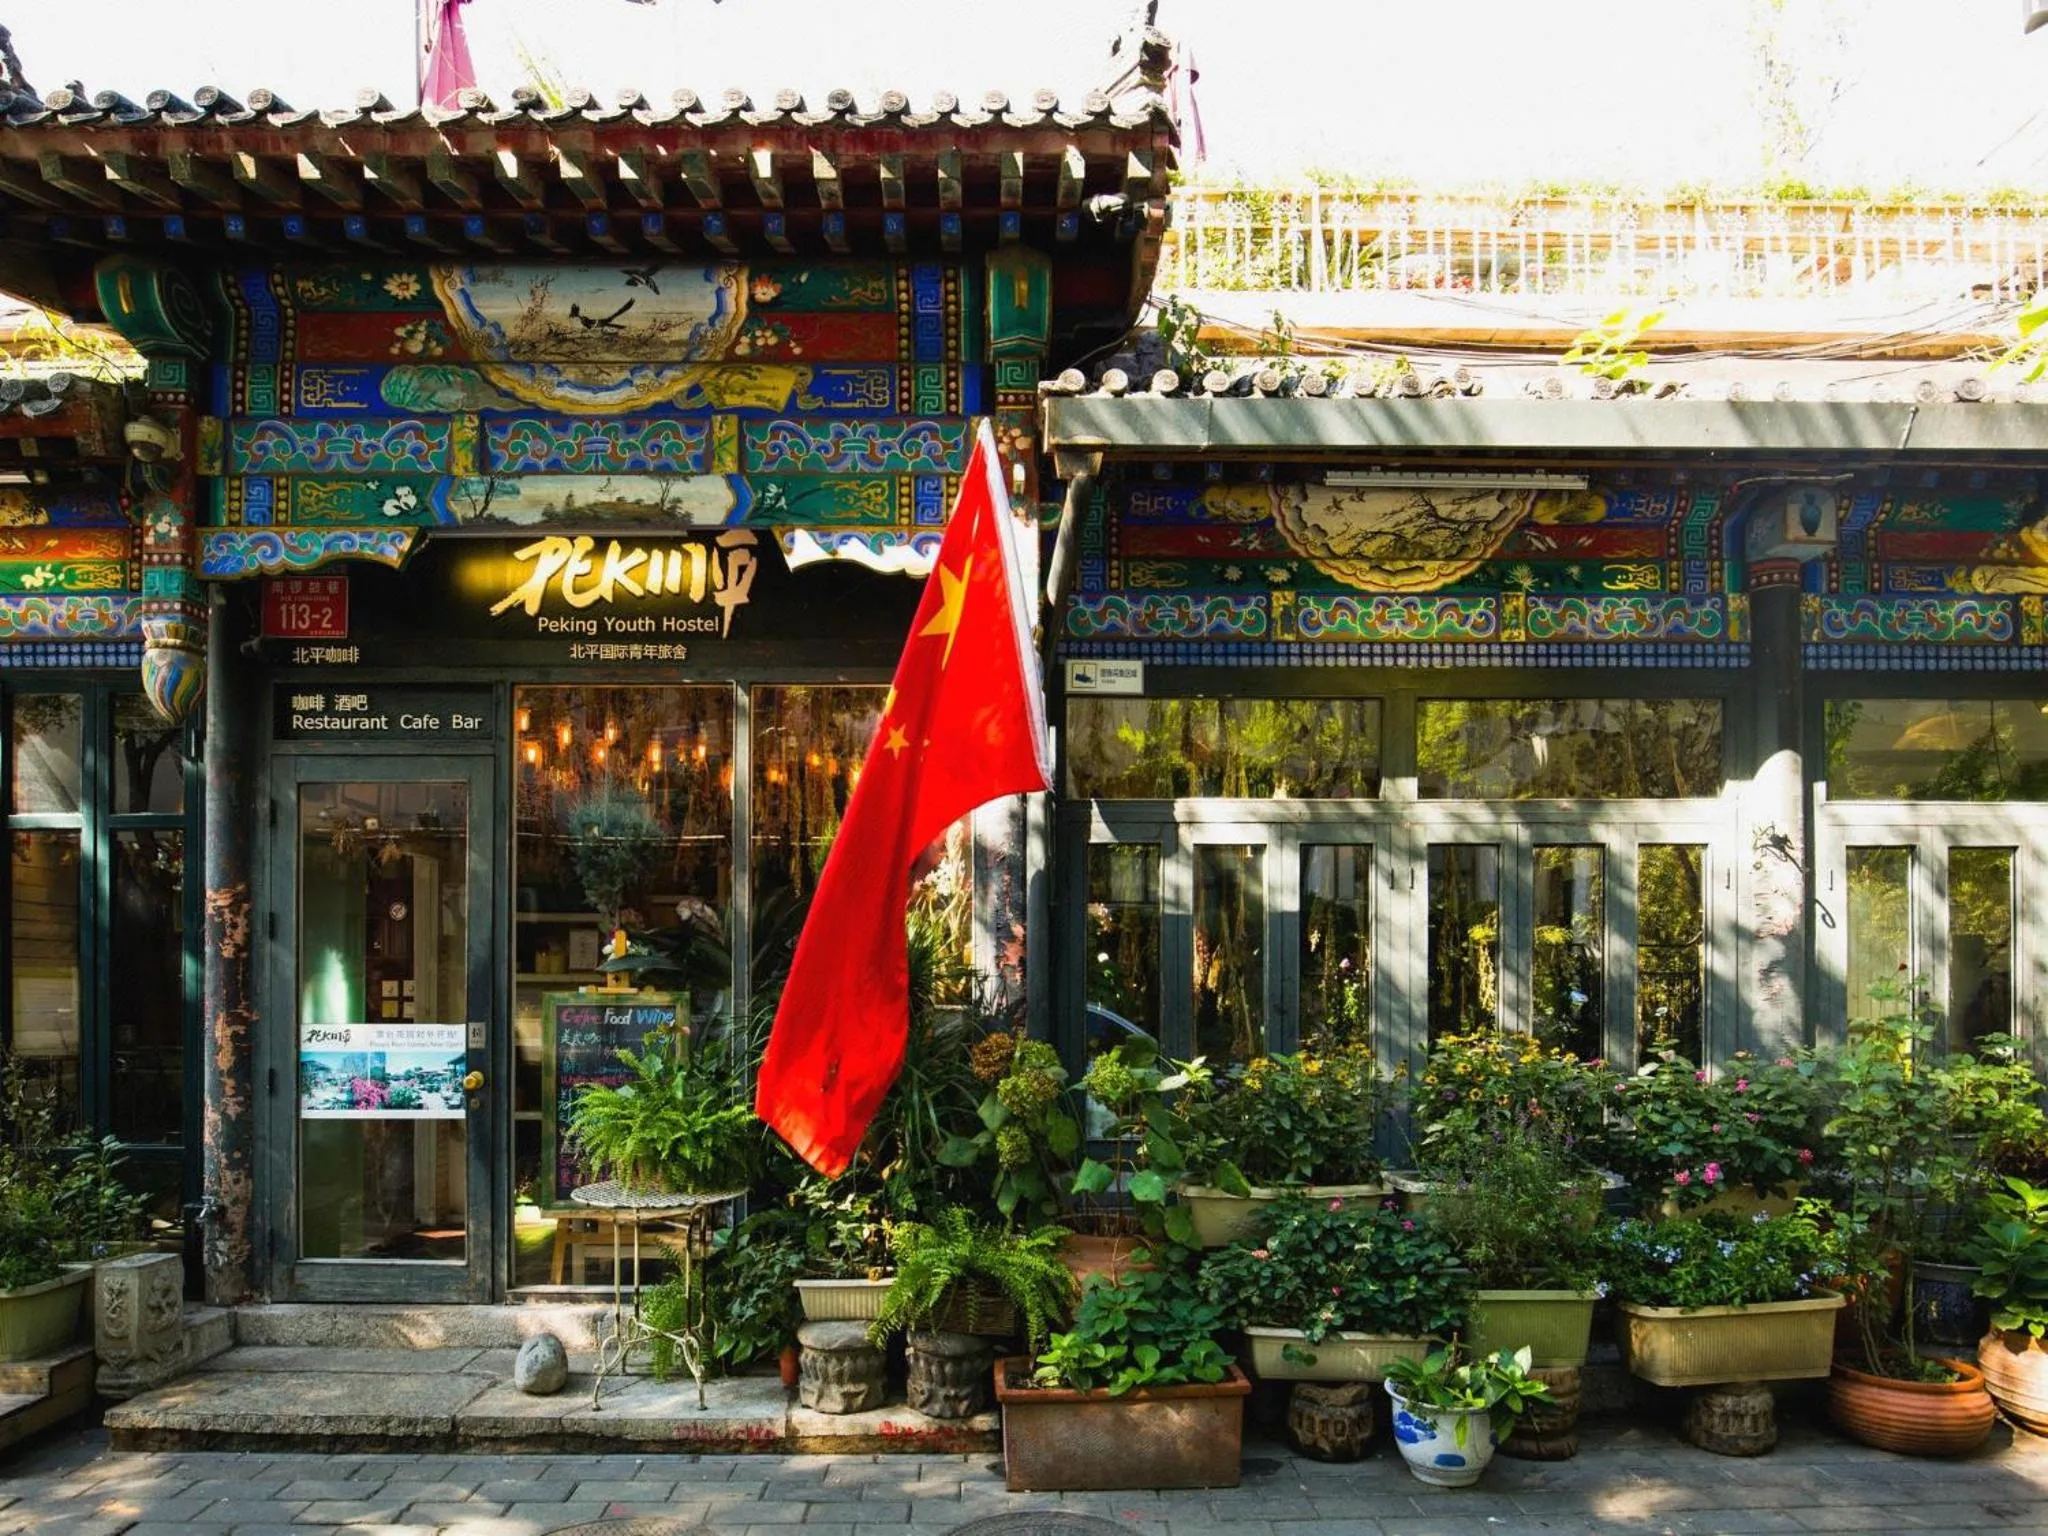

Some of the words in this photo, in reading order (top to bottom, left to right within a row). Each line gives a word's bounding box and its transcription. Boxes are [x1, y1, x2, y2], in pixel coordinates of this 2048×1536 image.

[280, 603, 333, 630] 113-2
[538, 617, 597, 635] Peking
[604, 617, 656, 632] Youth
[662, 616, 719, 632] Hostel
[291, 645, 360, 664] 北平咖啡
[569, 643, 688, 660] 北平国际青年旅舍
[291, 694, 325, 711] 咖啡
[333, 694, 369, 711] 酒吧
[293, 715, 389, 729] Restaurant
[400, 714, 440, 729] Cafe
[452, 714, 482, 729] Bar
[604, 1008, 633, 1025] Food
